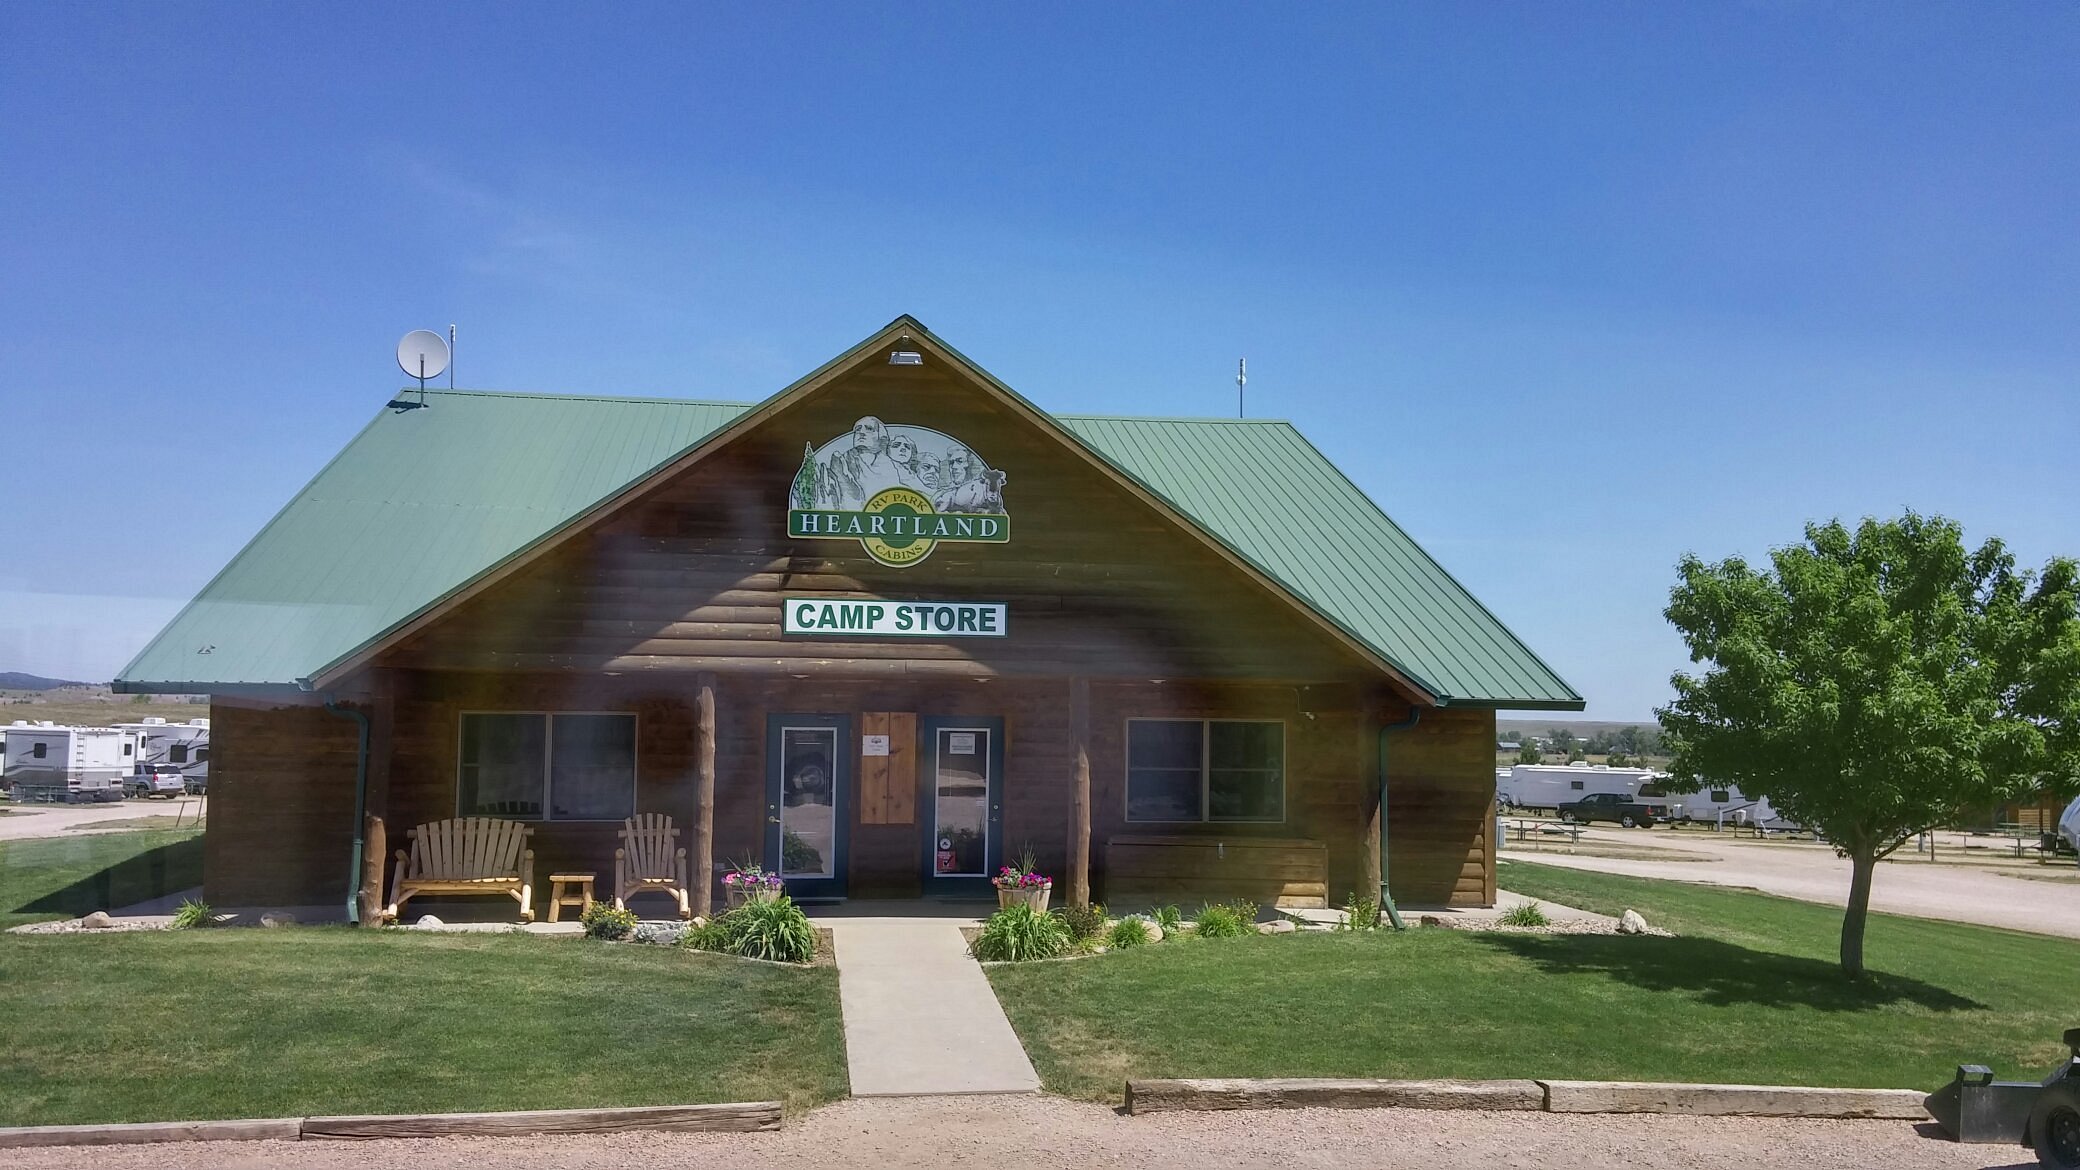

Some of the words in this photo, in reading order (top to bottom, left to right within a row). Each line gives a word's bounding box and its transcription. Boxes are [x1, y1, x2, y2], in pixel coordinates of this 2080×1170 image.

[872, 496, 888, 510] RV
[893, 494, 927, 511] PARK
[800, 515, 998, 537] HEARTLAND
[875, 545, 922, 559] CABINS
[796, 604, 884, 630] CAMP
[895, 606, 997, 632] STORE
